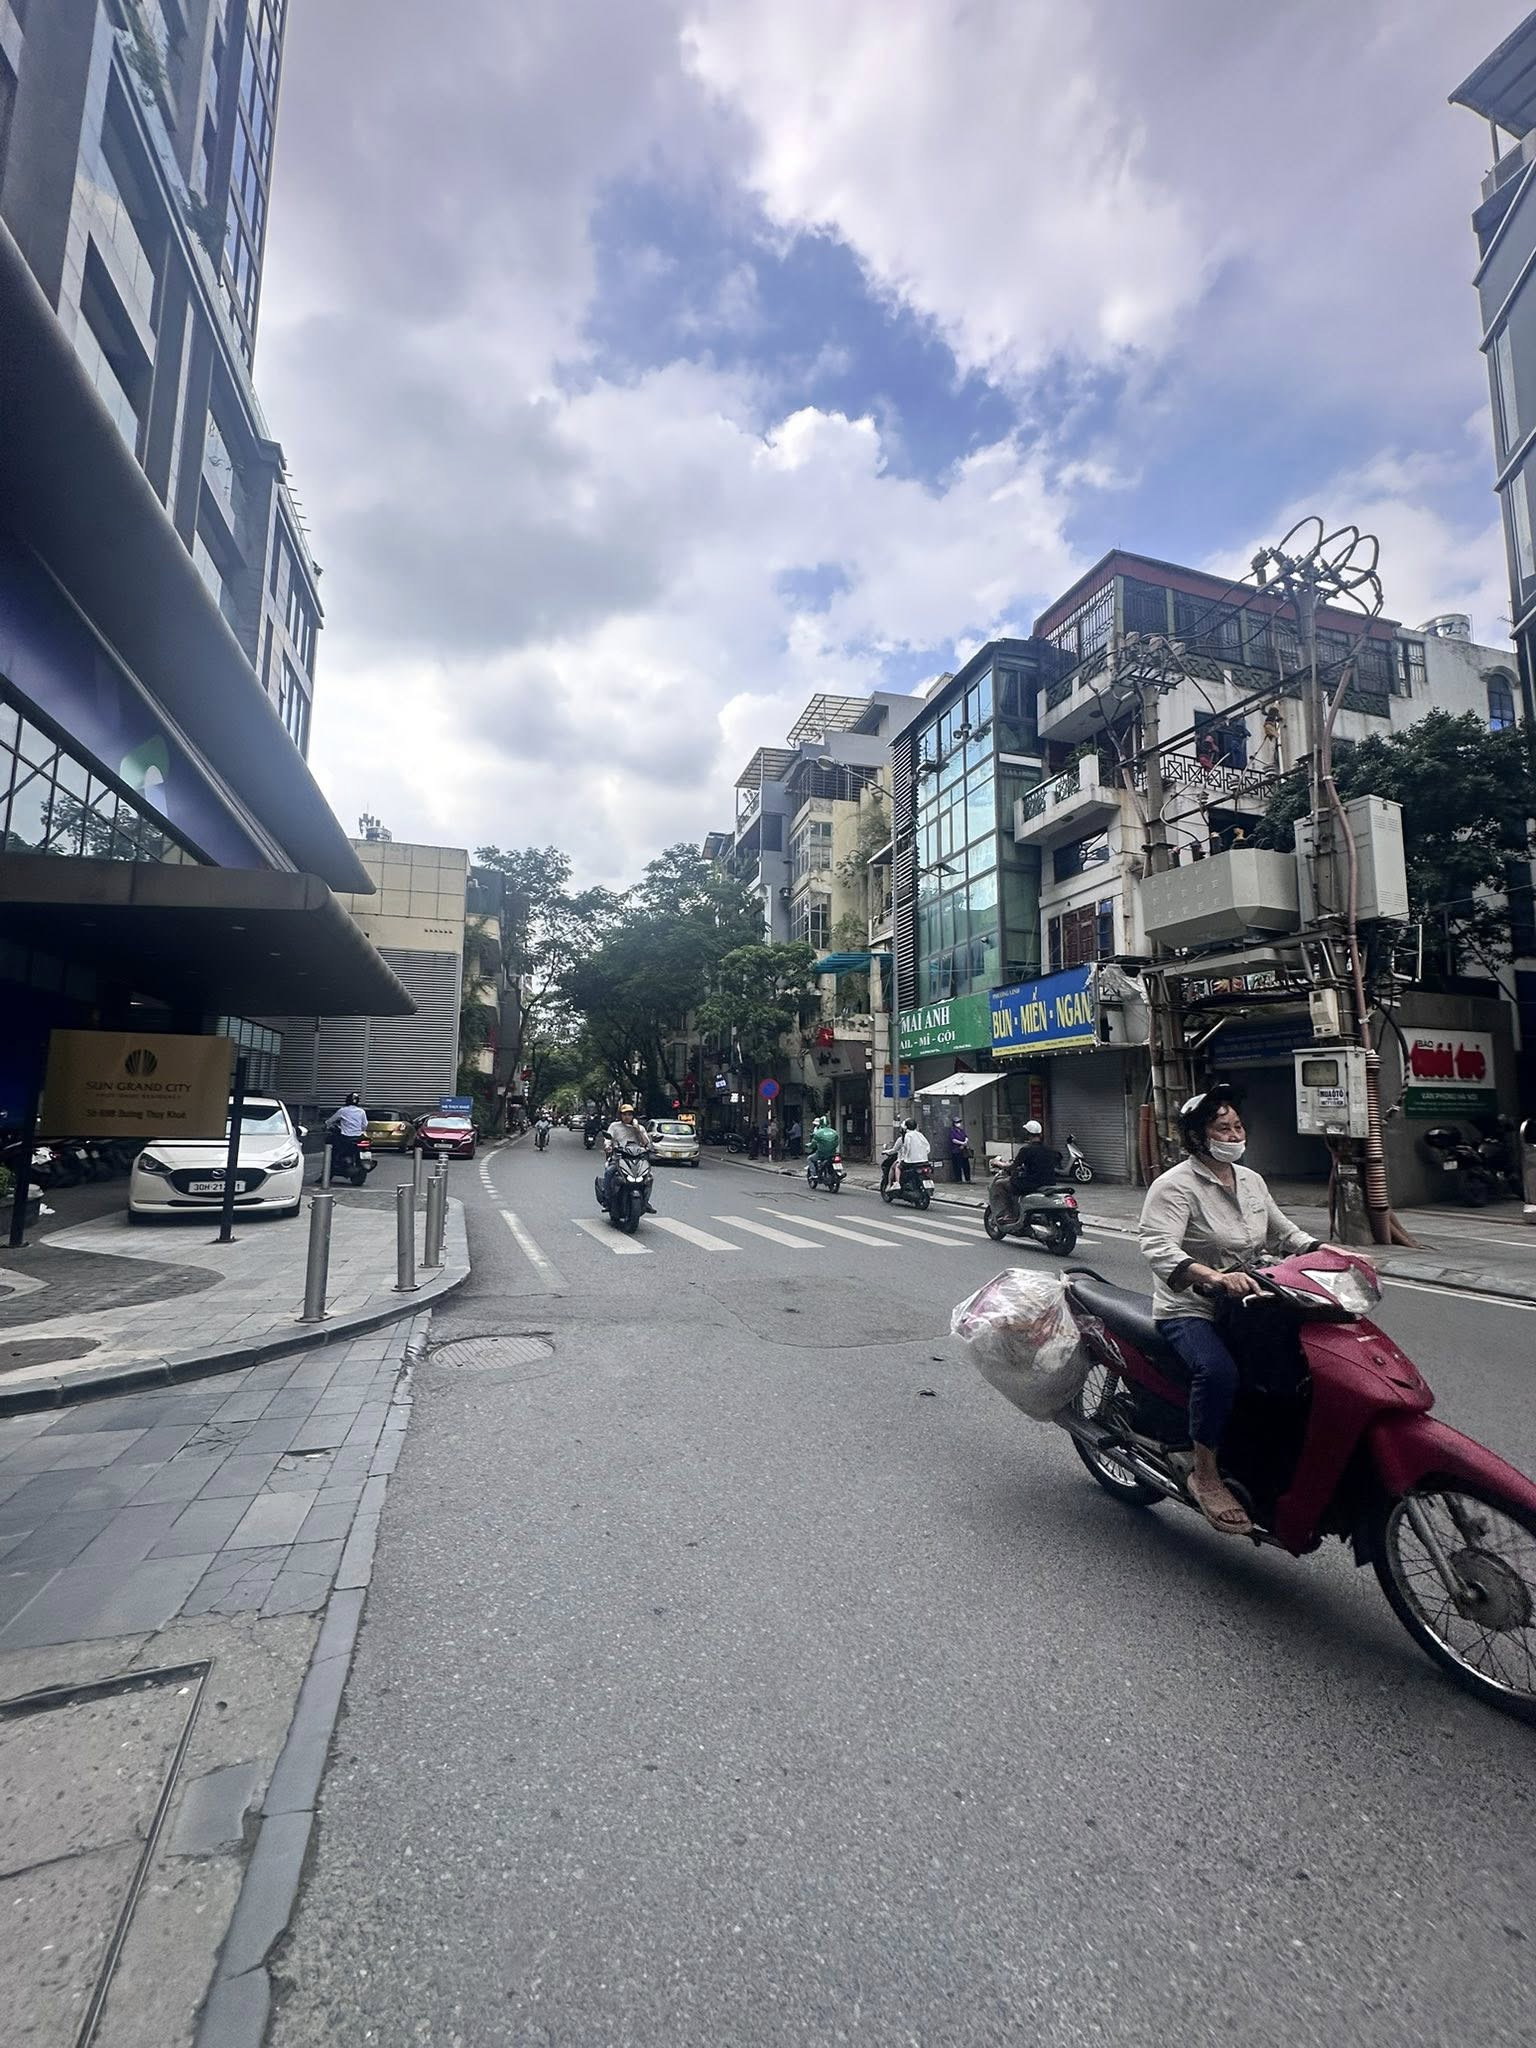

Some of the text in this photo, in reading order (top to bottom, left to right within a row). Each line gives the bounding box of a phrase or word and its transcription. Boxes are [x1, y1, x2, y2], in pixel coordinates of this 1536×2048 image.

[925, 1006, 950, 1029] ANH
[992, 1000, 1013, 1038] BÚN
[1020, 986, 1047, 1035] MIẾN
[1056, 991, 1092, 1028] NGAN
[85, 1081, 192, 1092] SUN GRAND CITY
